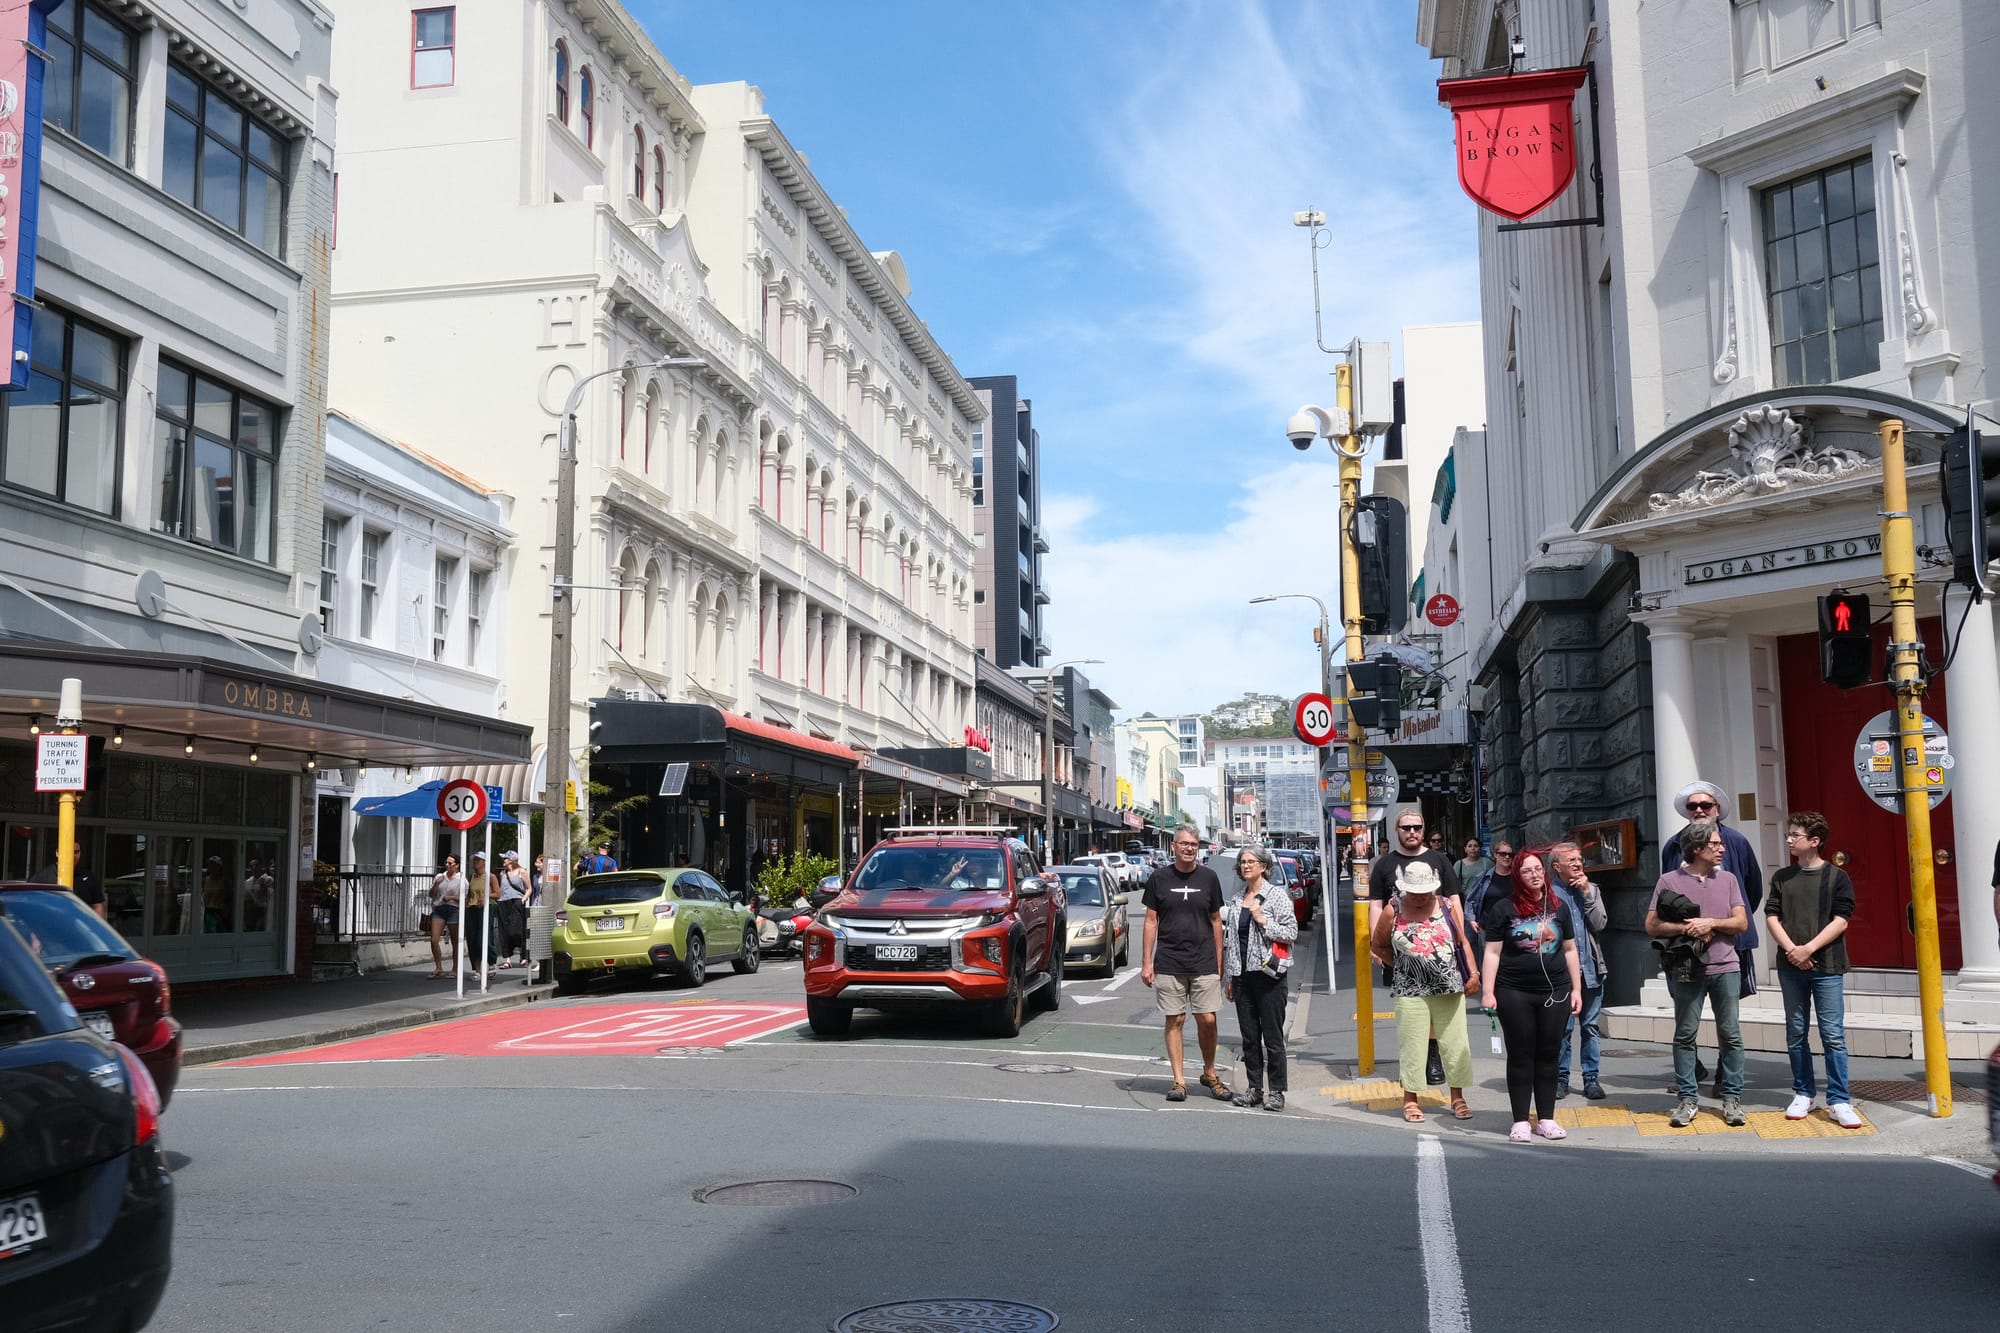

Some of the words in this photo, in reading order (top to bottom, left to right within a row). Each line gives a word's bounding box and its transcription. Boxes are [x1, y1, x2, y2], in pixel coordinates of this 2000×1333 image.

[1467, 121, 1562, 142] LOGAN
[1467, 141, 1564, 161] BROWN
[1684, 553, 1776, 582] LOGAN
[1429, 607, 1456, 615] ESTRELLA
[224, 680, 312, 718] OMBRA
[1306, 709, 1329, 729] 30
[1400, 713, 1440, 741] Matador
[40, 777, 81, 785] PEDESTRIANS
[448, 795, 475, 813] 30
[876, 947, 916, 958] MCC720
[0, 1202, 38, 1247] 28
